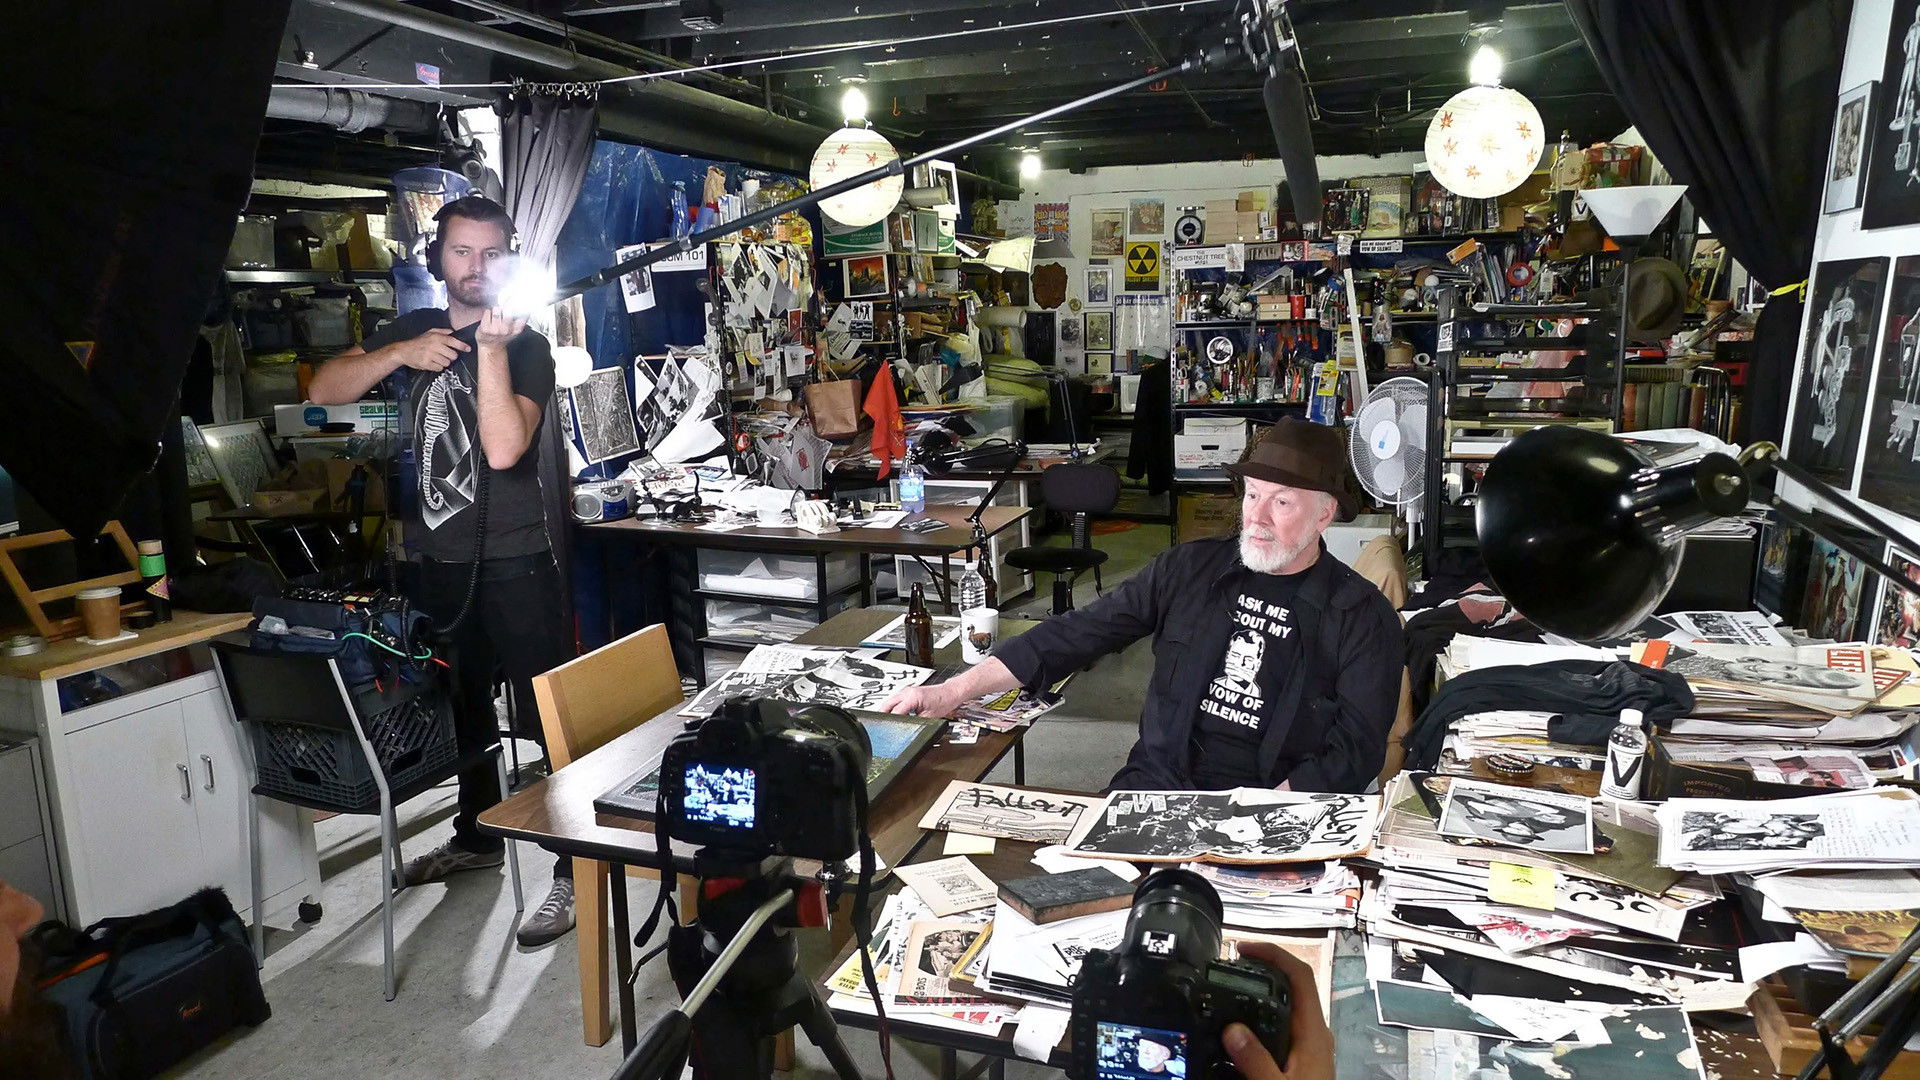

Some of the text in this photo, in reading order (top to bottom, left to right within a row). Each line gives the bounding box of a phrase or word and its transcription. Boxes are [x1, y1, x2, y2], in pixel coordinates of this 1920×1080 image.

[685, 250, 704, 260] 101
[1177, 254, 1208, 262] CHESTNUT
[1237, 594, 1290, 622] ASK ME
[1233, 610, 1292, 639] OUT MY
[1208, 683, 1264, 711] VOW OF
[1199, 698, 1260, 730] SILENCE
[1610, 749, 1643, 788] V
